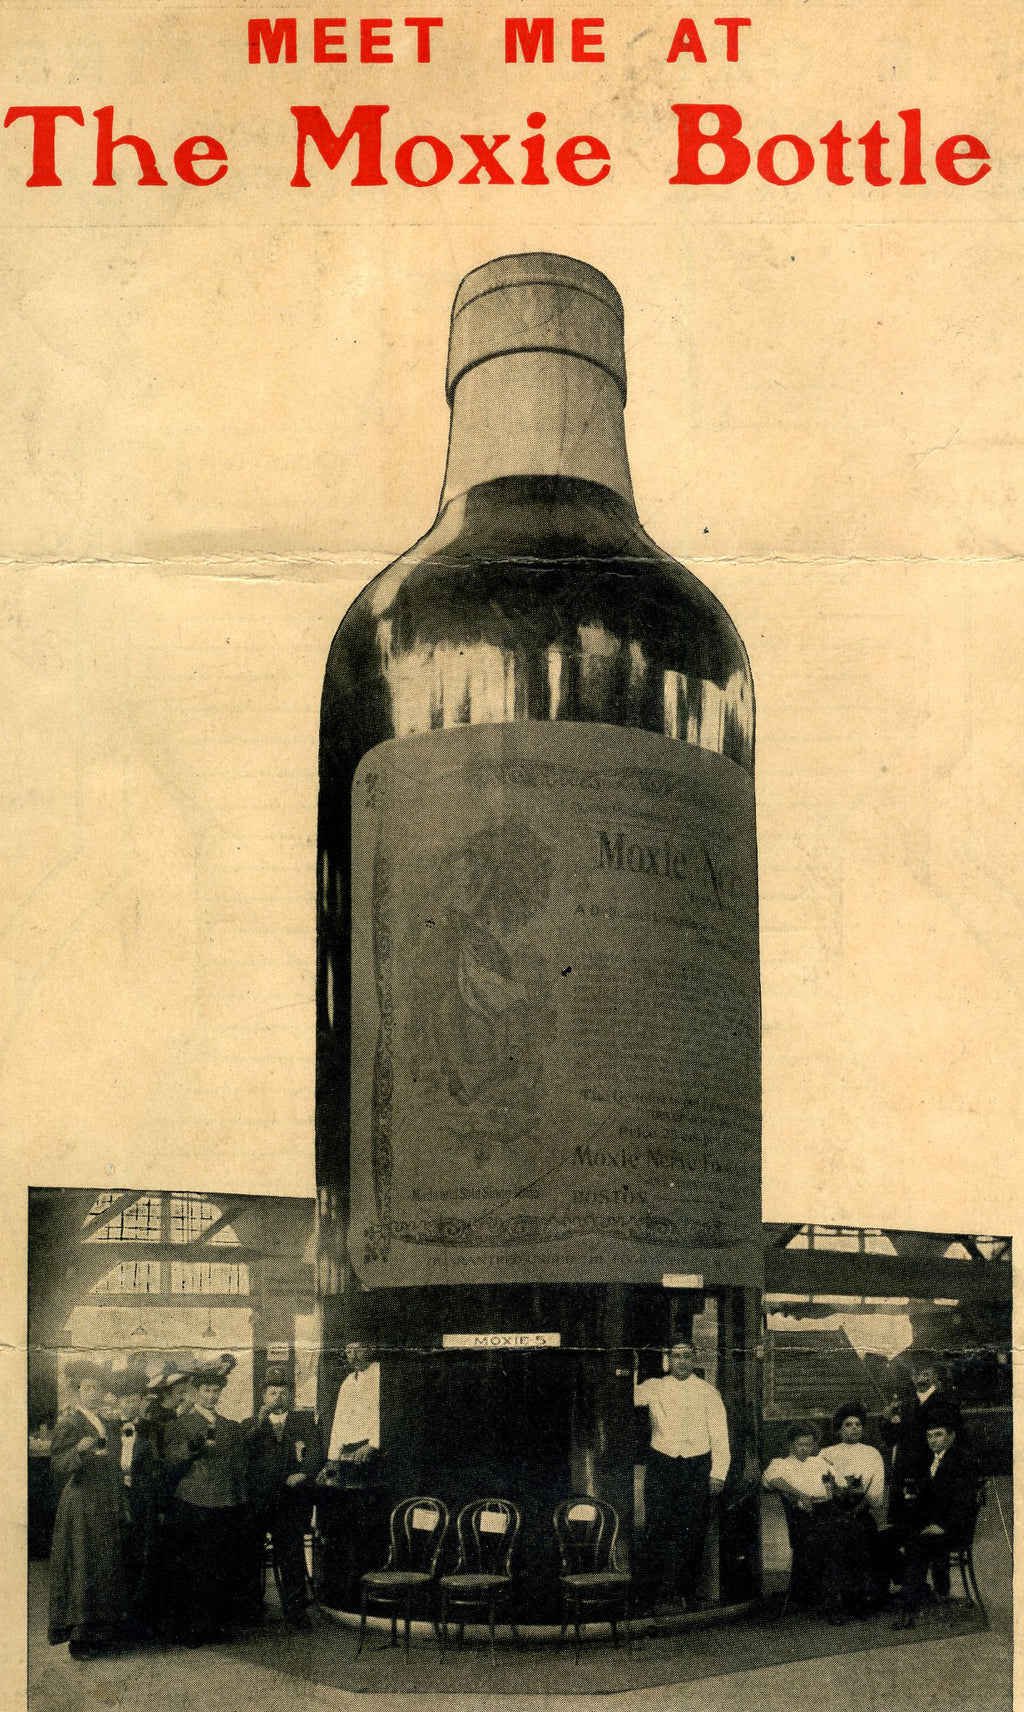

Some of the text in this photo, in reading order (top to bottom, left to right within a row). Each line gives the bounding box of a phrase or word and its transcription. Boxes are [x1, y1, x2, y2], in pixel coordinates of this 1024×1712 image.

[248, 17, 751, 64] MEET ME AT
[4, 104, 991, 187] The Moxie Bottle
[596, 830, 687, 881] Moxie
[571, 1145, 639, 1169] Moxie
[571, 1188, 647, 1204] BOSTON
[474, 1335, 547, 1346] MOXIE 5
